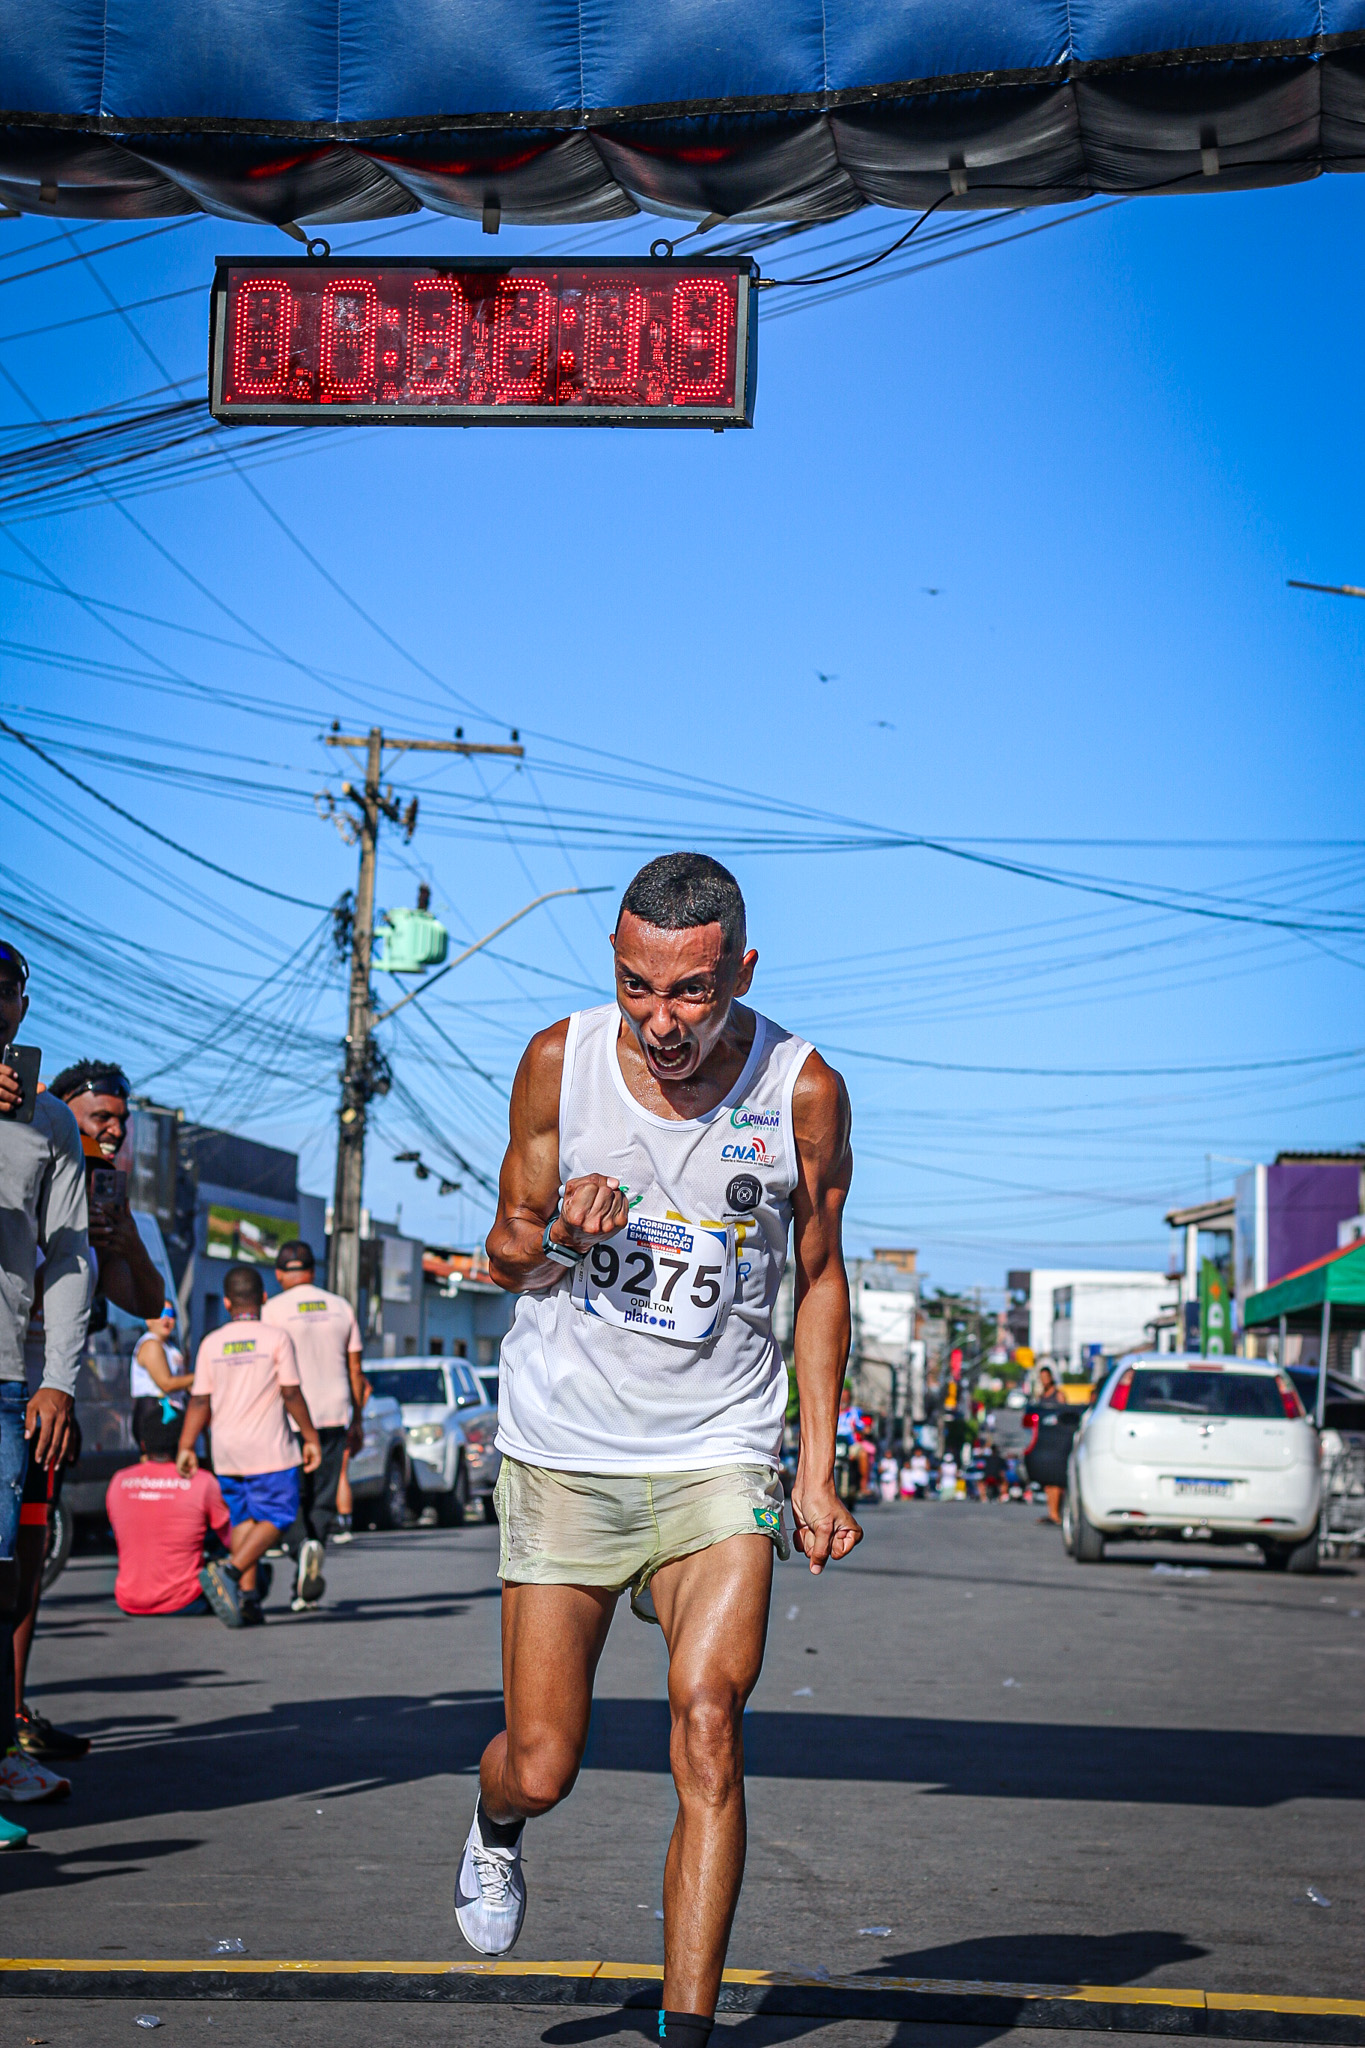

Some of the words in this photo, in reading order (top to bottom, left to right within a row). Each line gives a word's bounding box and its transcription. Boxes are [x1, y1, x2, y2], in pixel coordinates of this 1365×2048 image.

[630, 1224, 680, 1241] CAMINHADA
[681, 1235, 692, 1243] da
[640, 1219, 677, 1233] CORRIDA
[630, 1231, 691, 1250] EMANCIPAÇÃO
[590, 1243, 722, 1309] 9275
[630, 1297, 674, 1314] ODILTON
